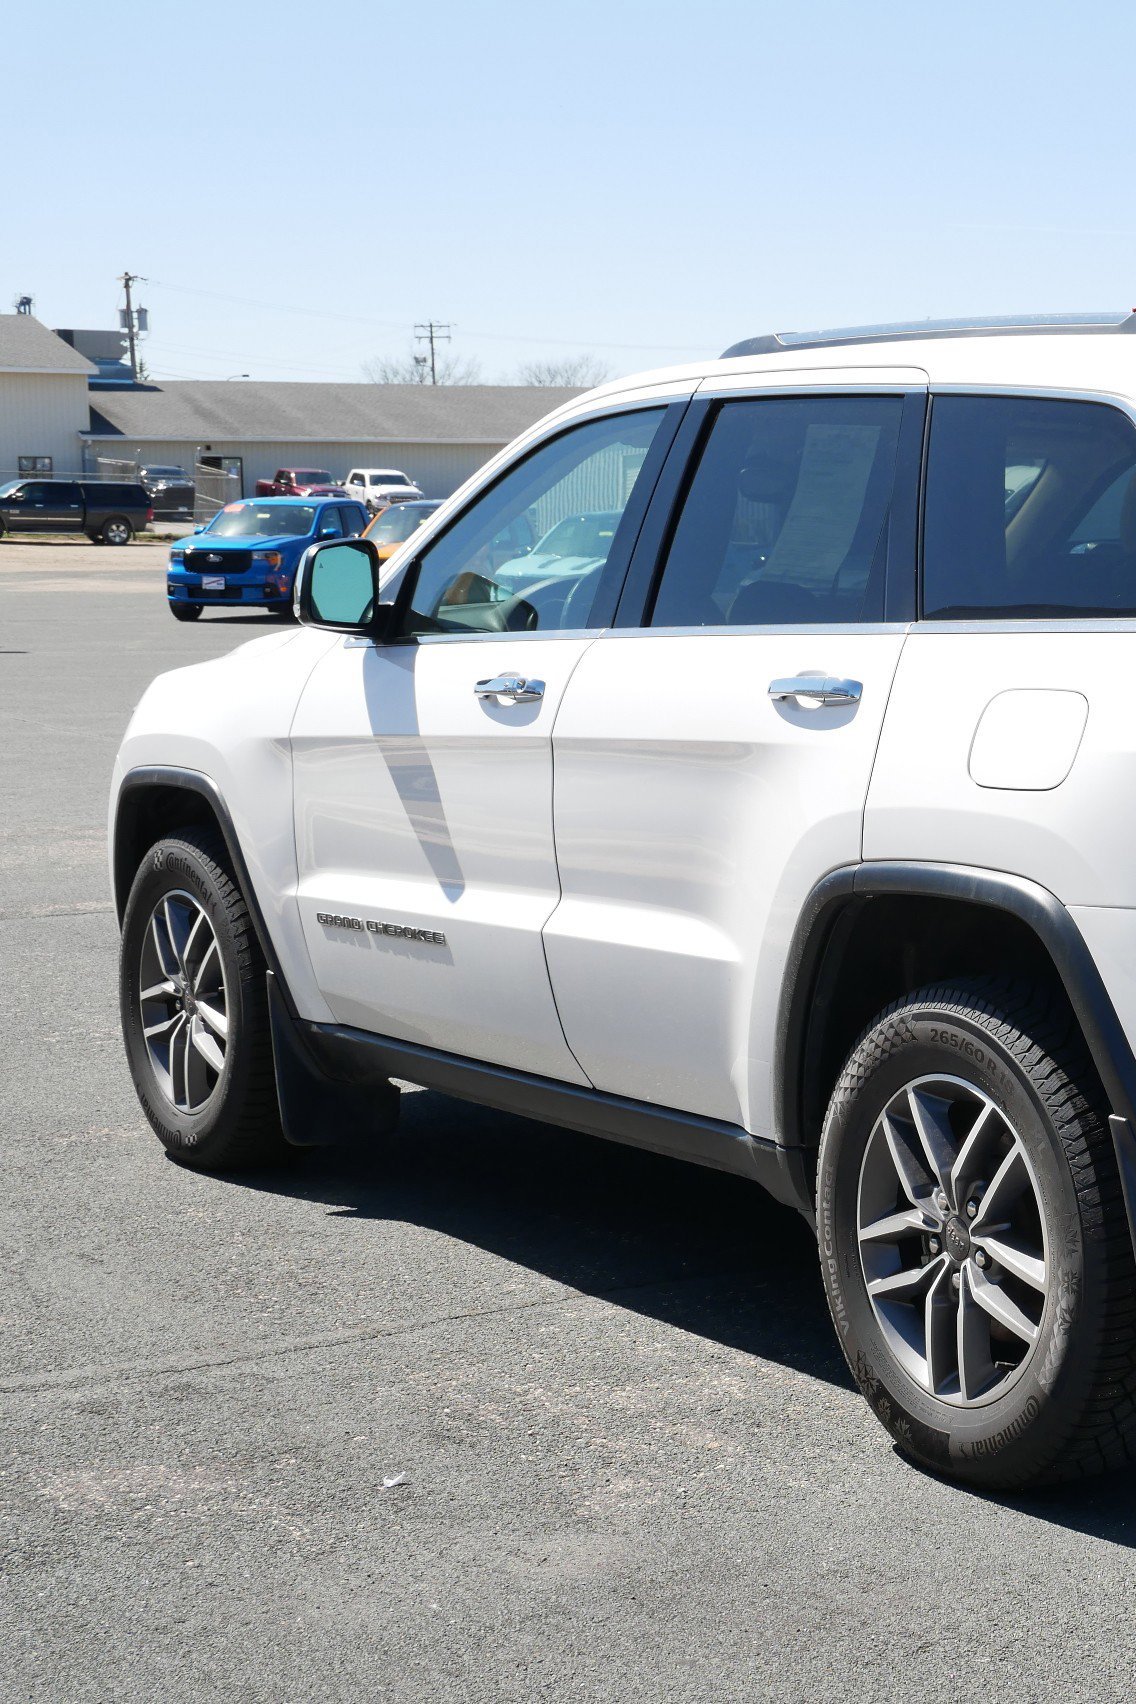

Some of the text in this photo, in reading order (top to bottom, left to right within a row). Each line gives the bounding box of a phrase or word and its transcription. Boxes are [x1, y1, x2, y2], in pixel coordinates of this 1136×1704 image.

[317, 911, 447, 946] GRAND CHEROKEE
[930, 1028, 985, 1064] 265/60
